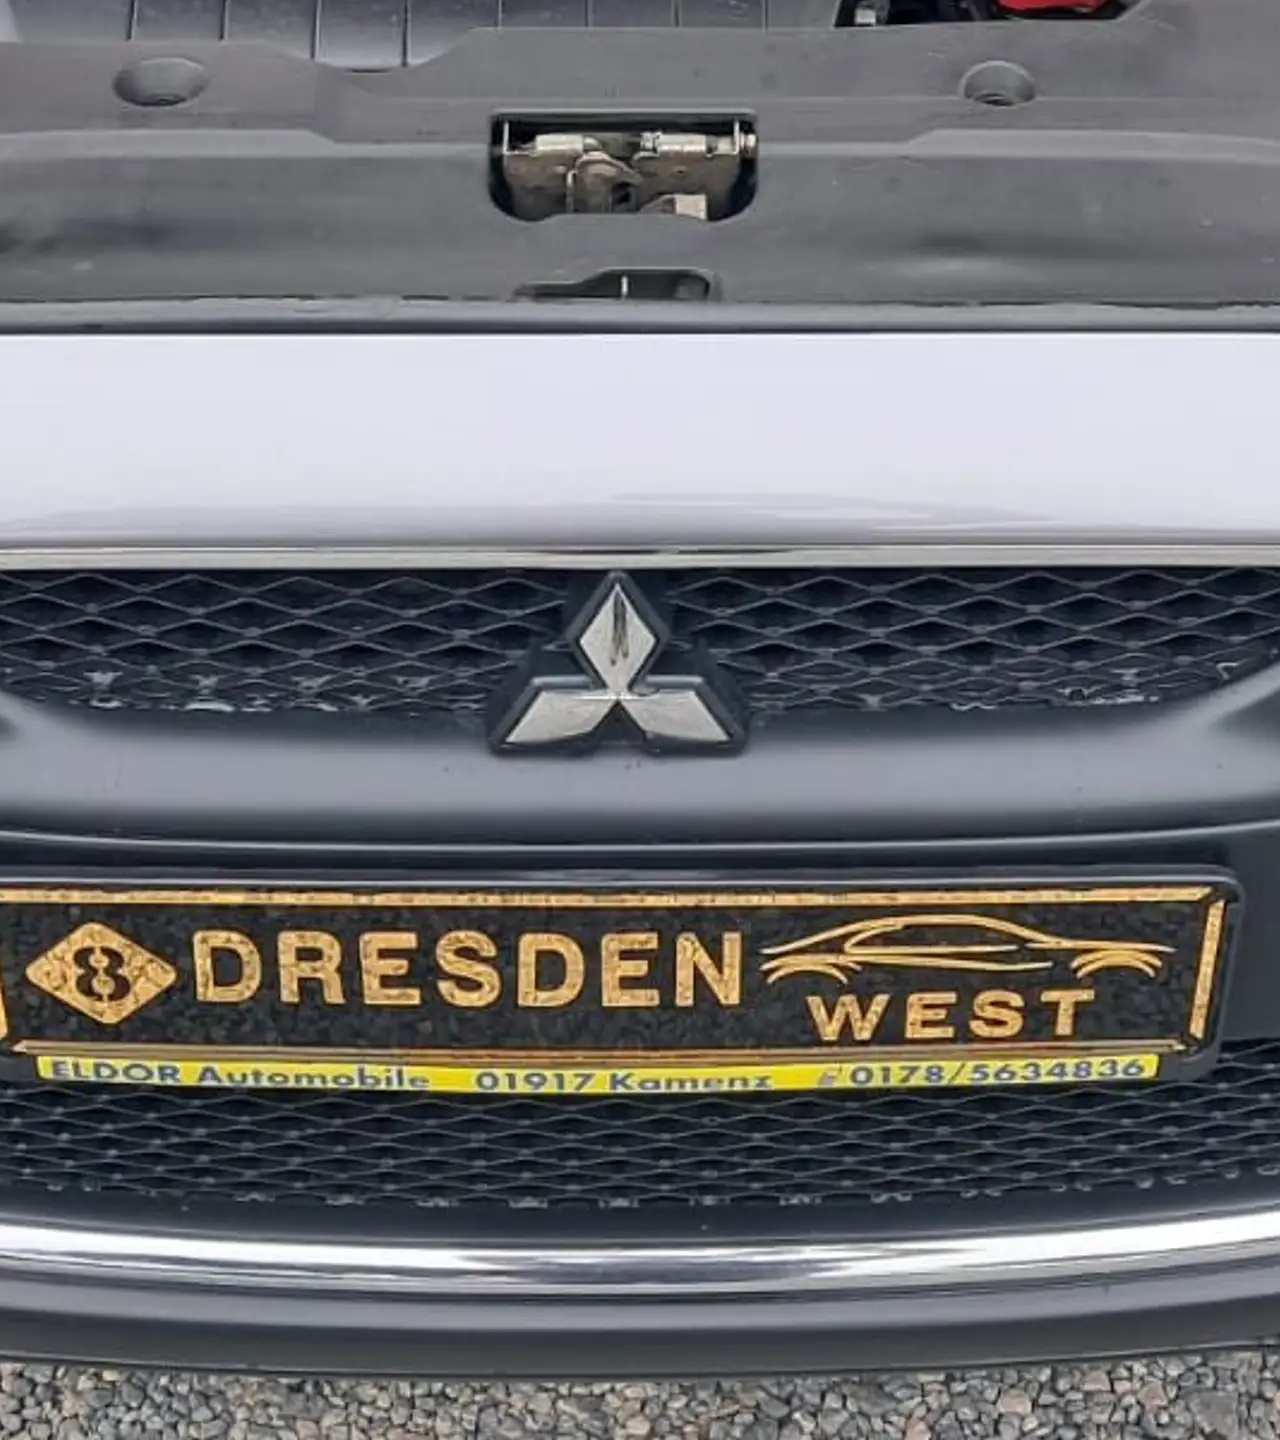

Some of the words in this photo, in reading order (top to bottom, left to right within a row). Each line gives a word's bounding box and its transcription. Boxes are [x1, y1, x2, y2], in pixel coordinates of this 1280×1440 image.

[192, 929, 743, 1008] DRESDEN
[805, 988, 1096, 1042] WEST
[50, 1060, 181, 1083] ELDOR
[197, 1063, 431, 1090] Automobile
[474, 1071, 596, 1092] 01917
[608, 1072, 773, 1091] Kamenz
[849, 1059, 1146, 1086] 0178/5634836
